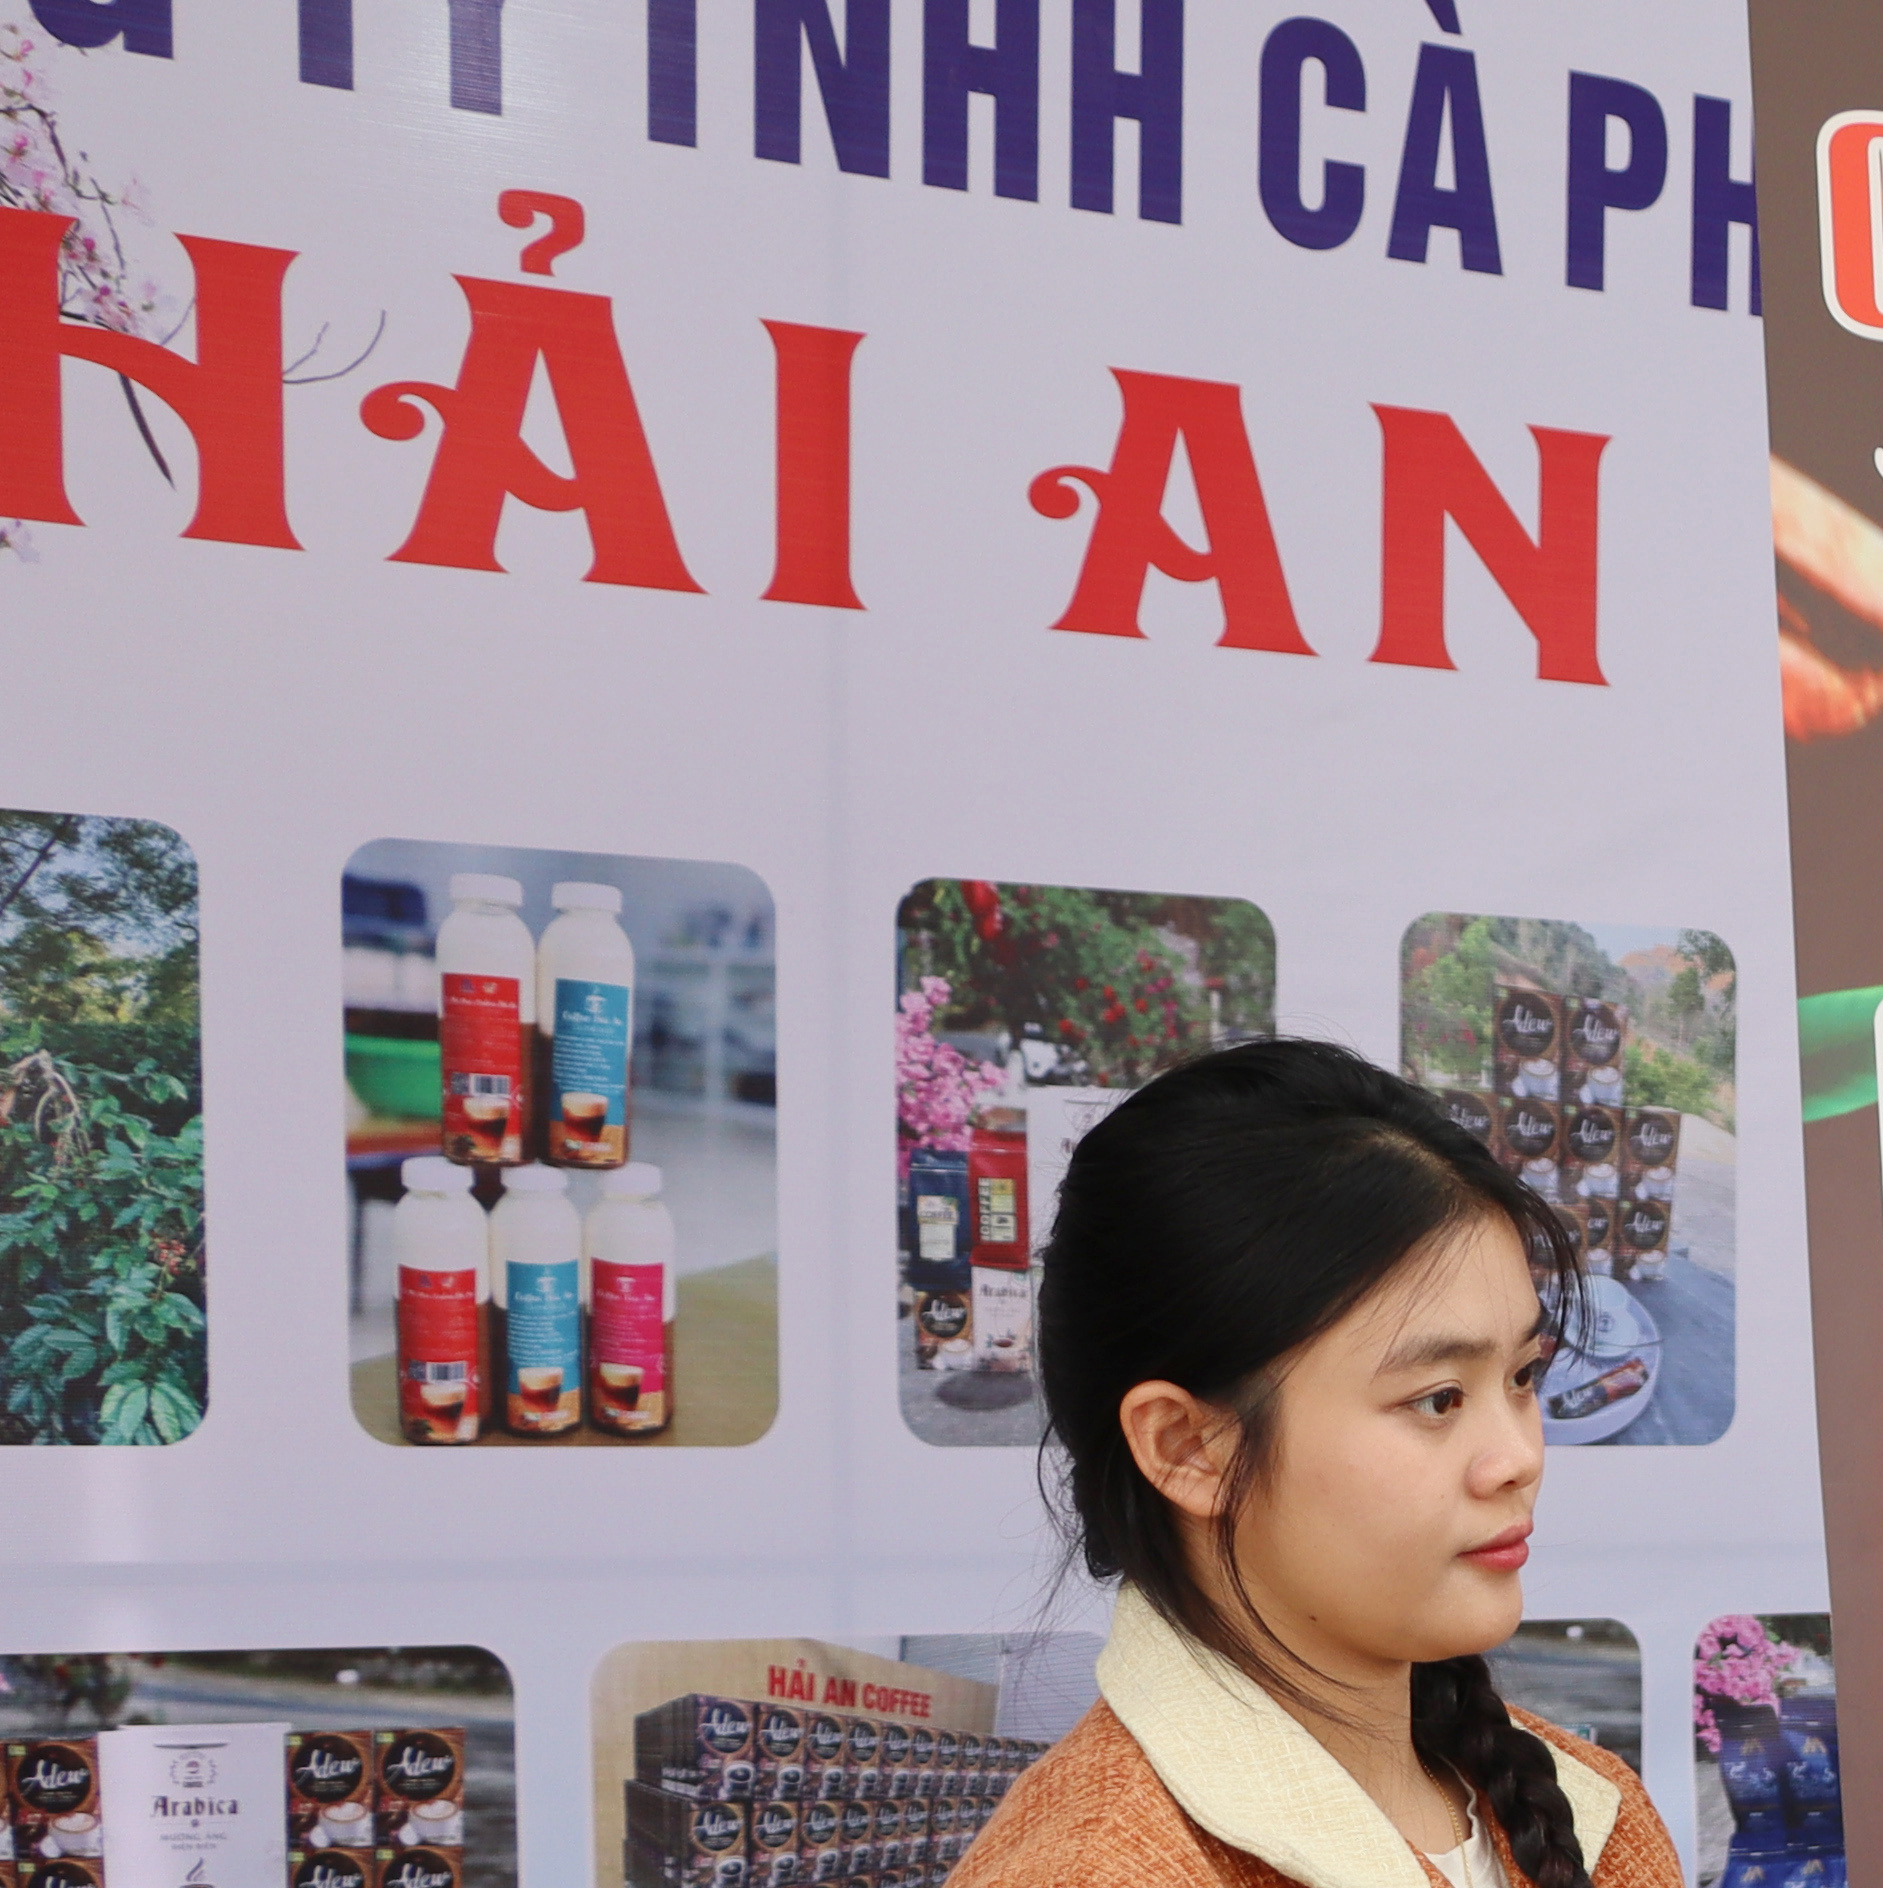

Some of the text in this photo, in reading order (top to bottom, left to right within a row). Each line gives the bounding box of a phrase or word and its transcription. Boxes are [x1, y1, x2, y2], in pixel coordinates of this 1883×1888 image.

[1259, 0, 1503, 277] CÀ
[0, 188, 1612, 688] HẢI AN
[823, 1676, 858, 1708] AN
[862, 1682, 932, 1718] COFFEE
[151, 1795, 239, 1819] Arabica
